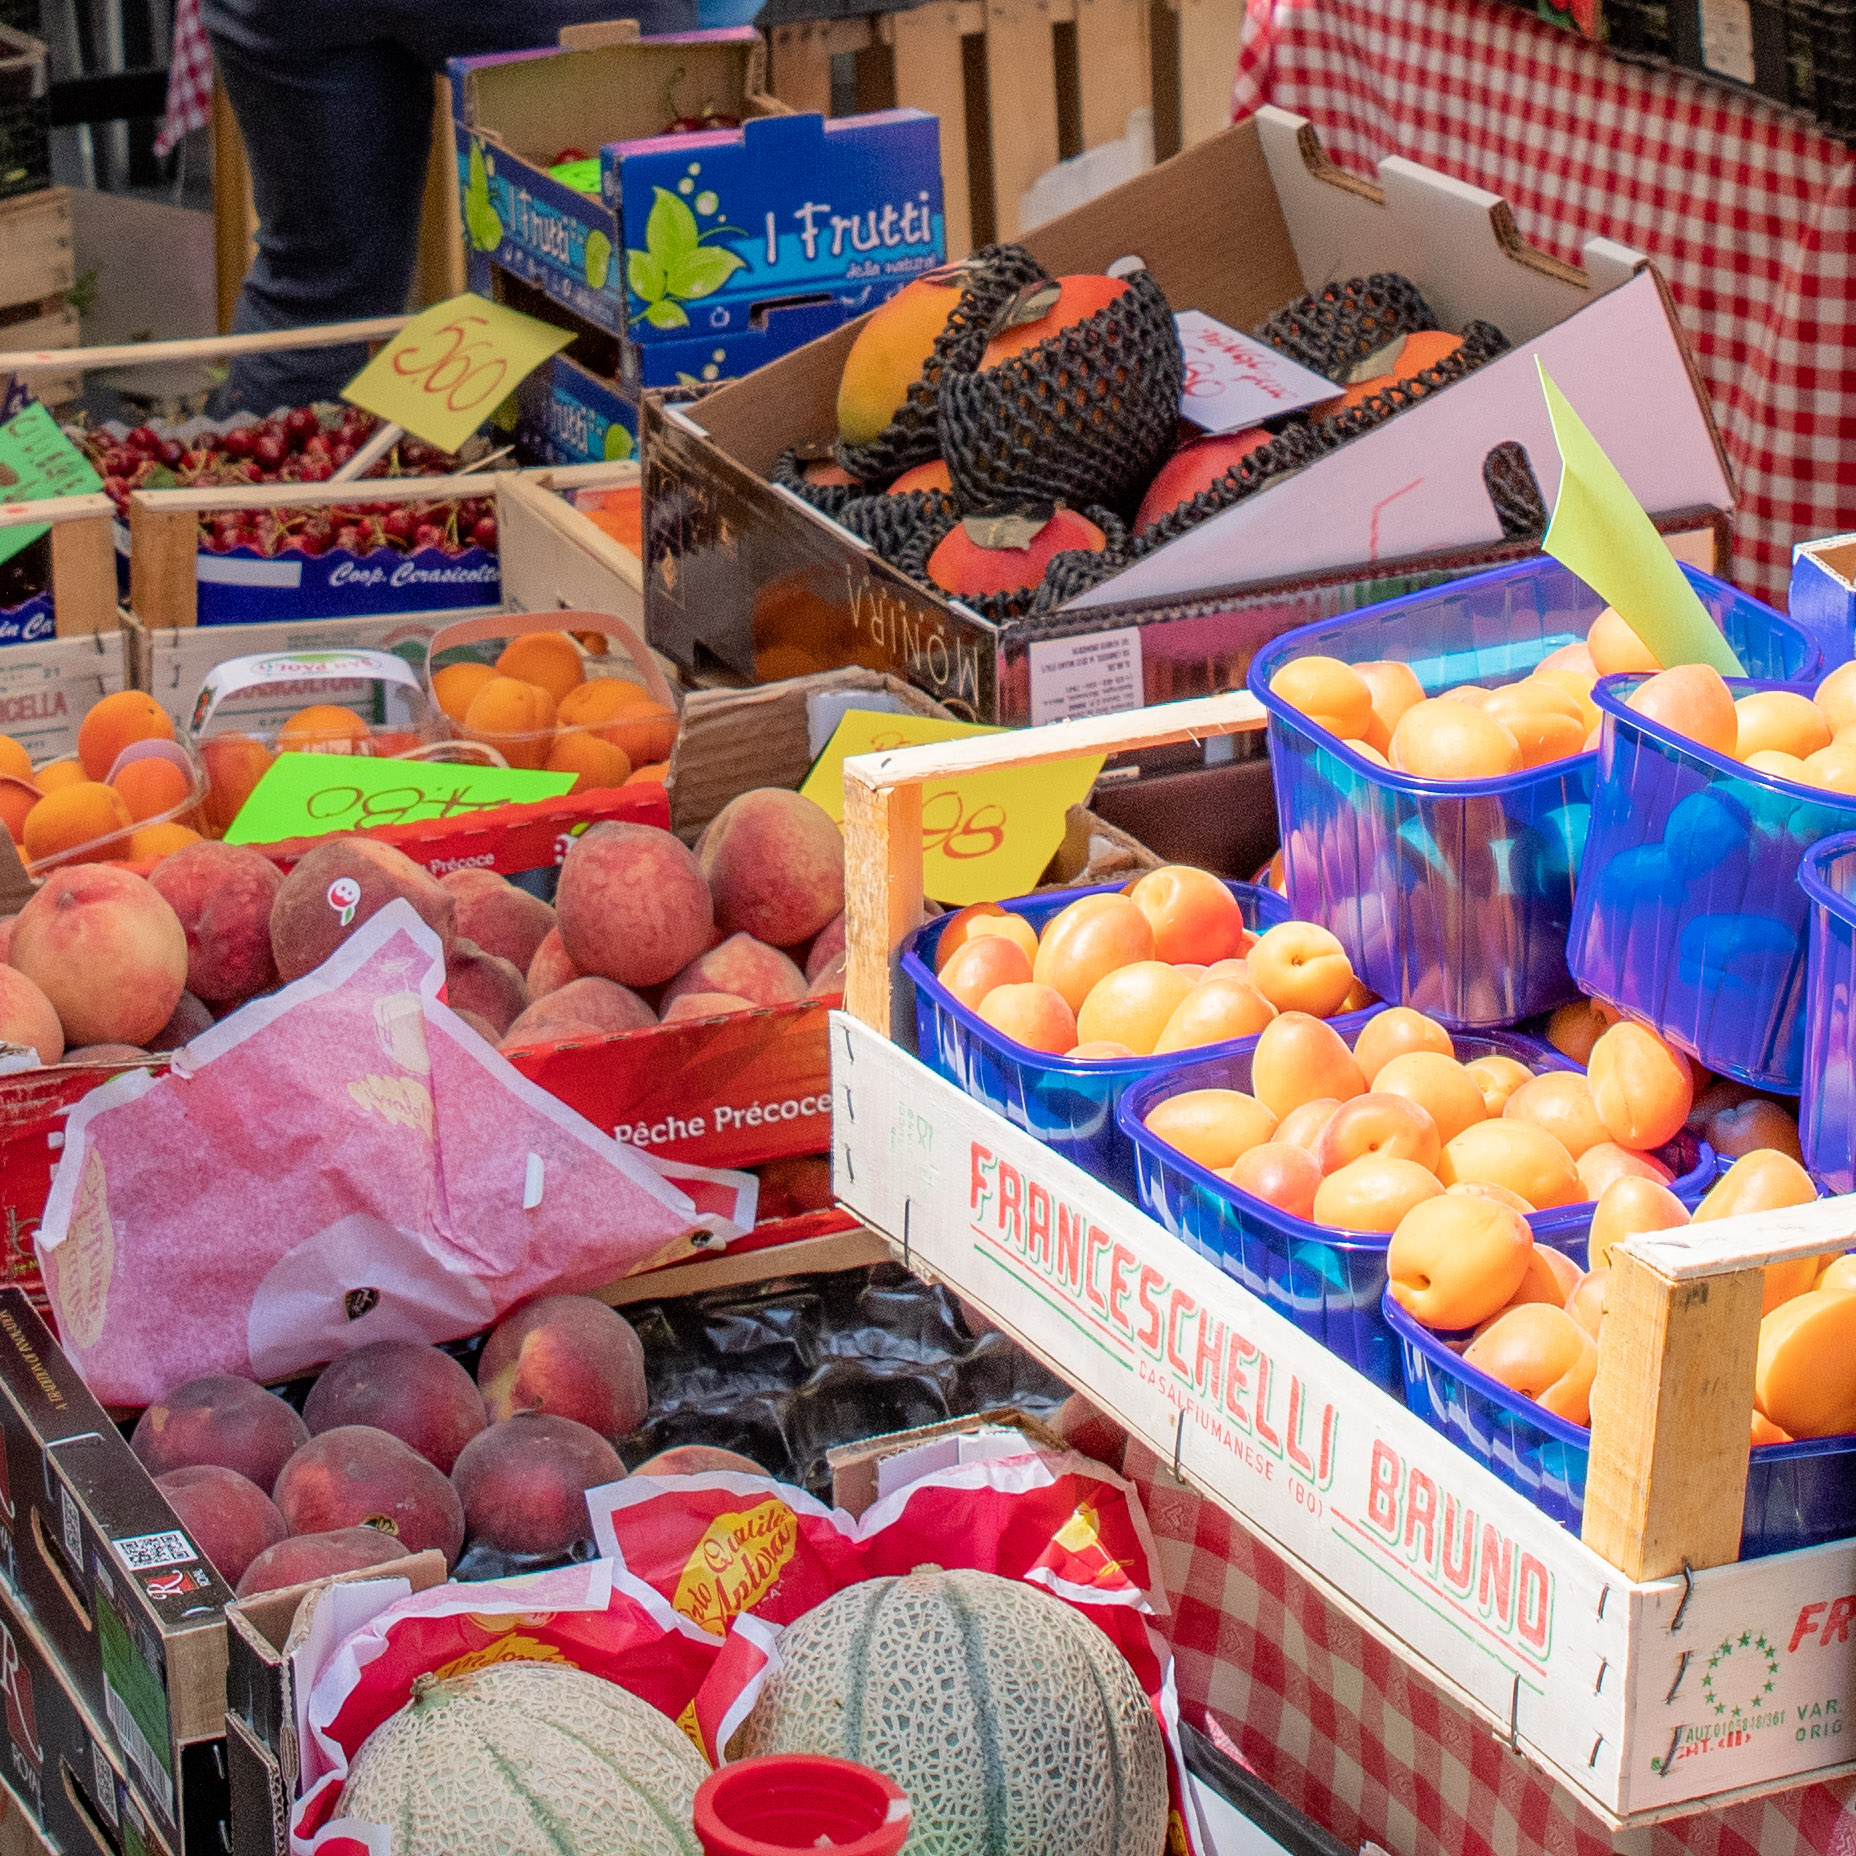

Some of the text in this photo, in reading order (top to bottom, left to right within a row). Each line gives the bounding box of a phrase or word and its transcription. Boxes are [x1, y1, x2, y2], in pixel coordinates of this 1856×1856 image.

[795, 191, 931, 259] Frutti
[329, 561, 387, 587] Coop.
[430, 851, 495, 875] Précoce
[615, 1093, 832, 1146] Pêche Précoce
[970, 1141, 1555, 1664] FRANCESCHELLI BRUNO
[1139, 1360, 1274, 1482] CASALFIUMANESE
